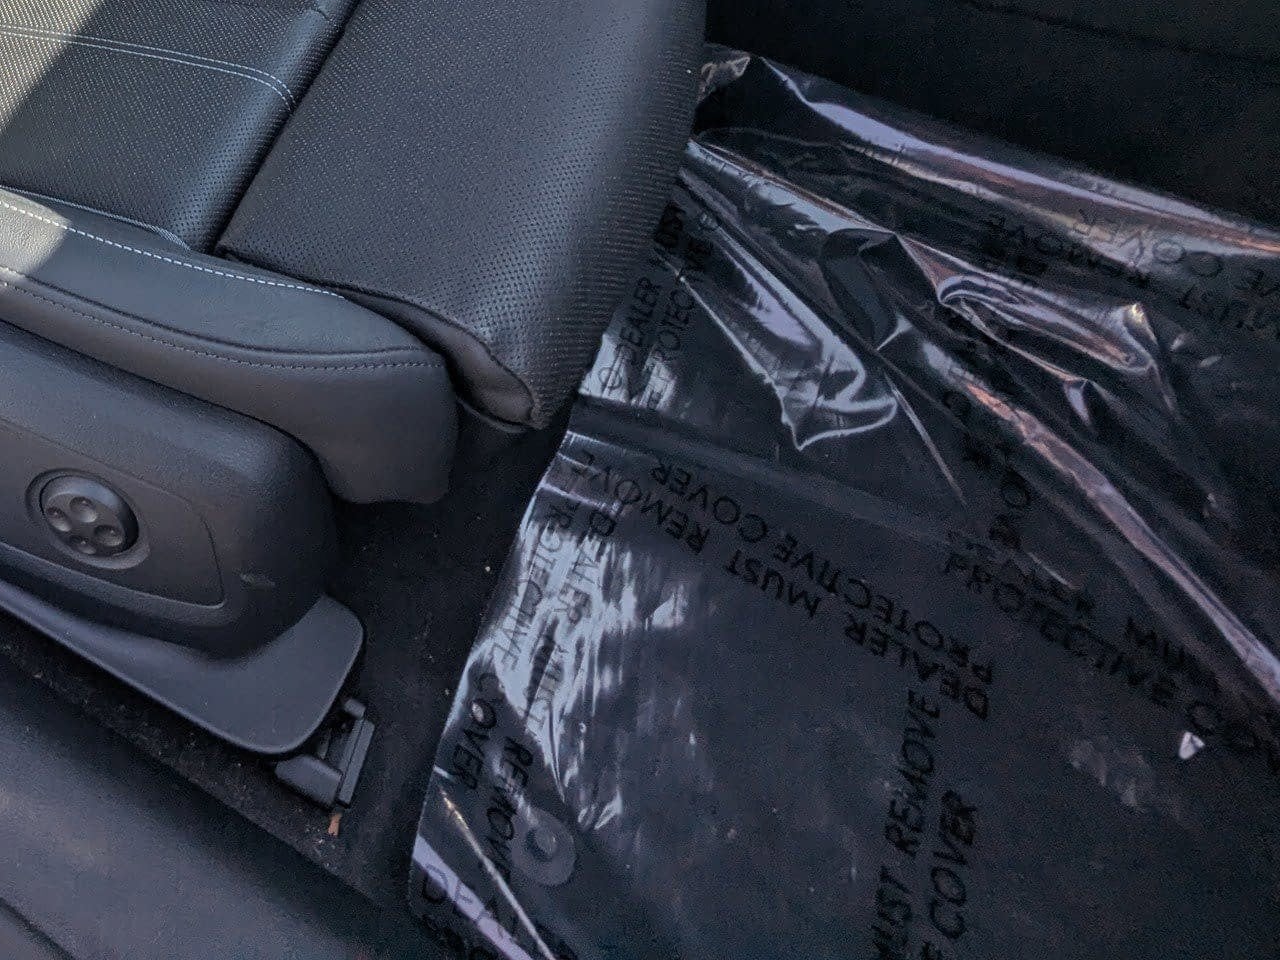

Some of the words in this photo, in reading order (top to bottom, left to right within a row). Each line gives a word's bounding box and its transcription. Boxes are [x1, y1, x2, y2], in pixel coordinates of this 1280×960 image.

[649, 459, 770, 543] COVER
[723, 549, 821, 618] MUST
[775, 534, 994, 685] PROTECTIVE
[844, 612, 991, 720] DEALER
[449, 671, 498, 791] COVER
[884, 690, 941, 858] REMOVE
[929, 789, 978, 940] COVER
